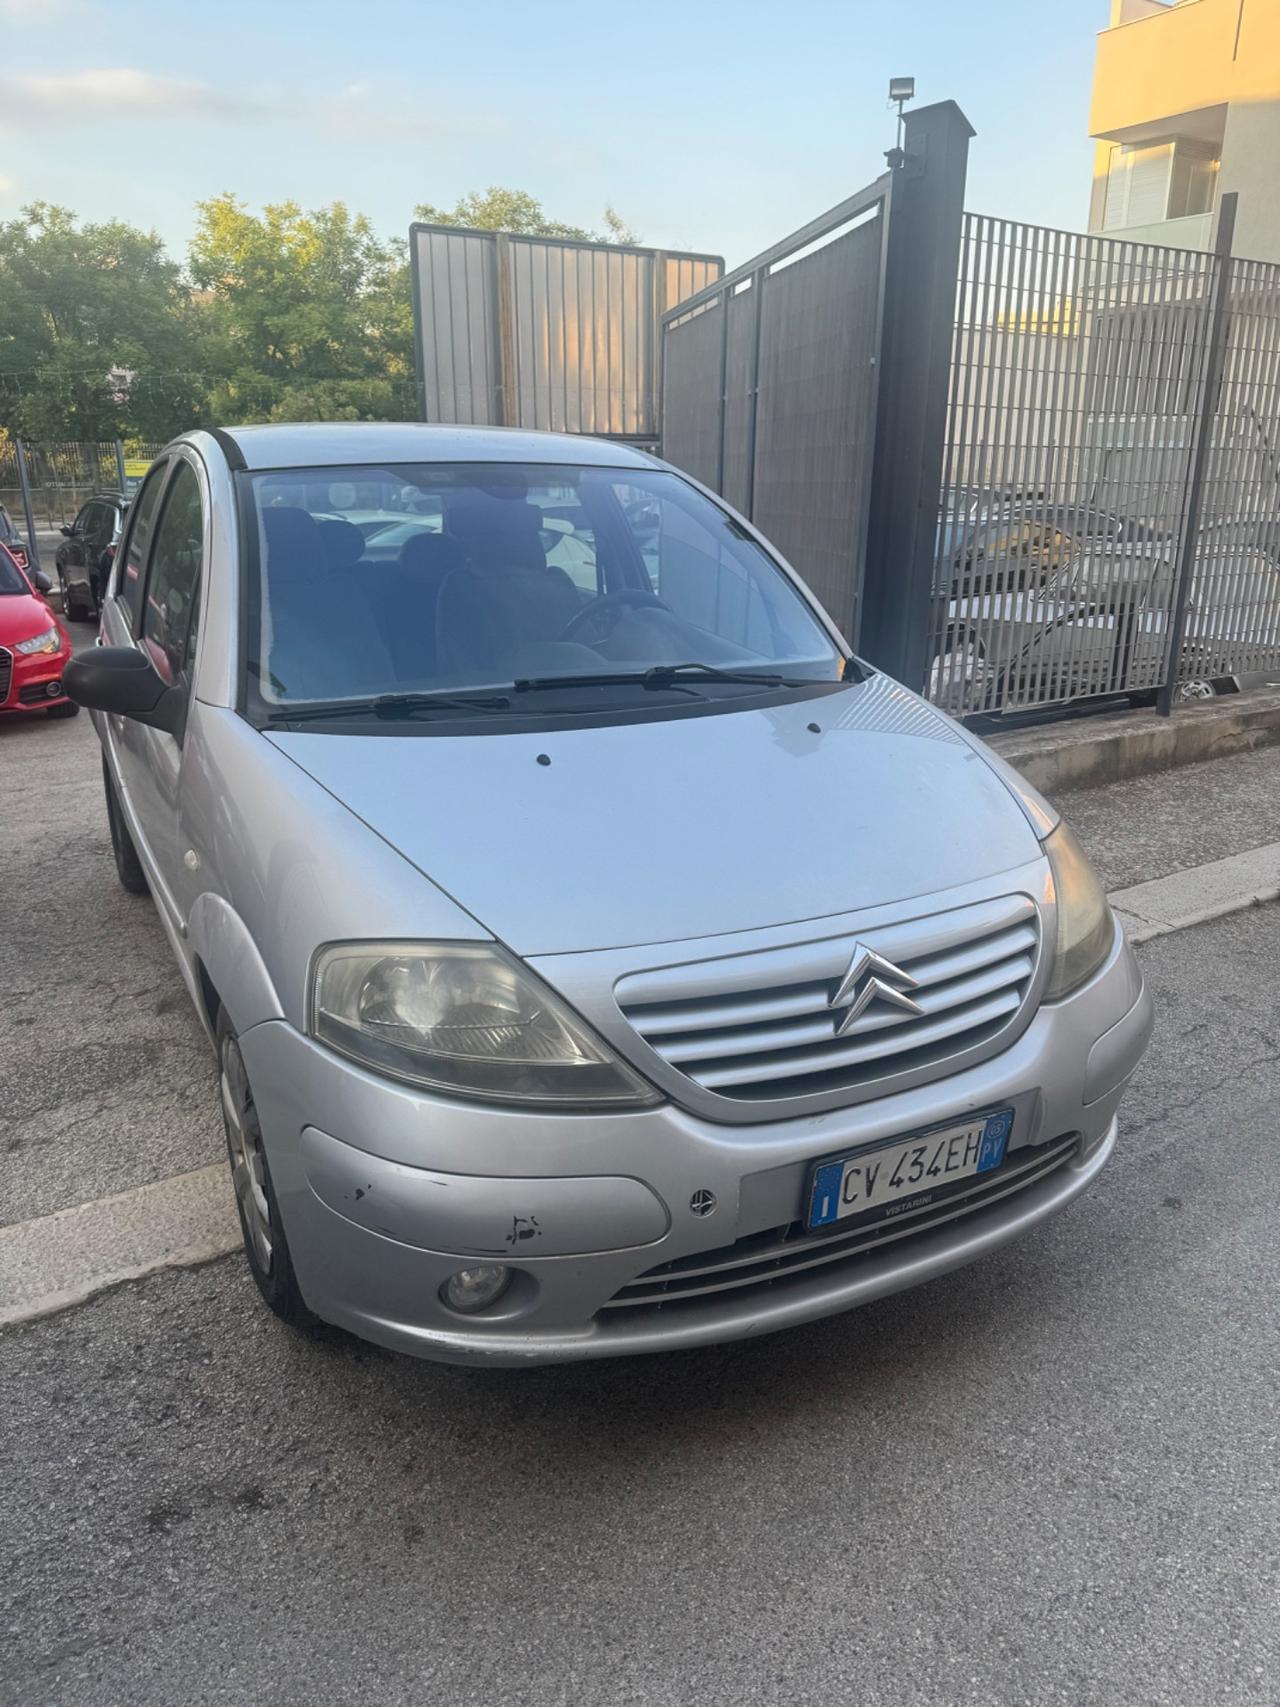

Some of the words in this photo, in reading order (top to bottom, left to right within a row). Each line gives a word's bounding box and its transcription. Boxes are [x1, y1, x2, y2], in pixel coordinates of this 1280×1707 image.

[981, 1138, 1002, 1163] PV
[842, 1162, 881, 1204] CV
[889, 1129, 983, 1188] 434EH
[821, 1196, 829, 1218] I
